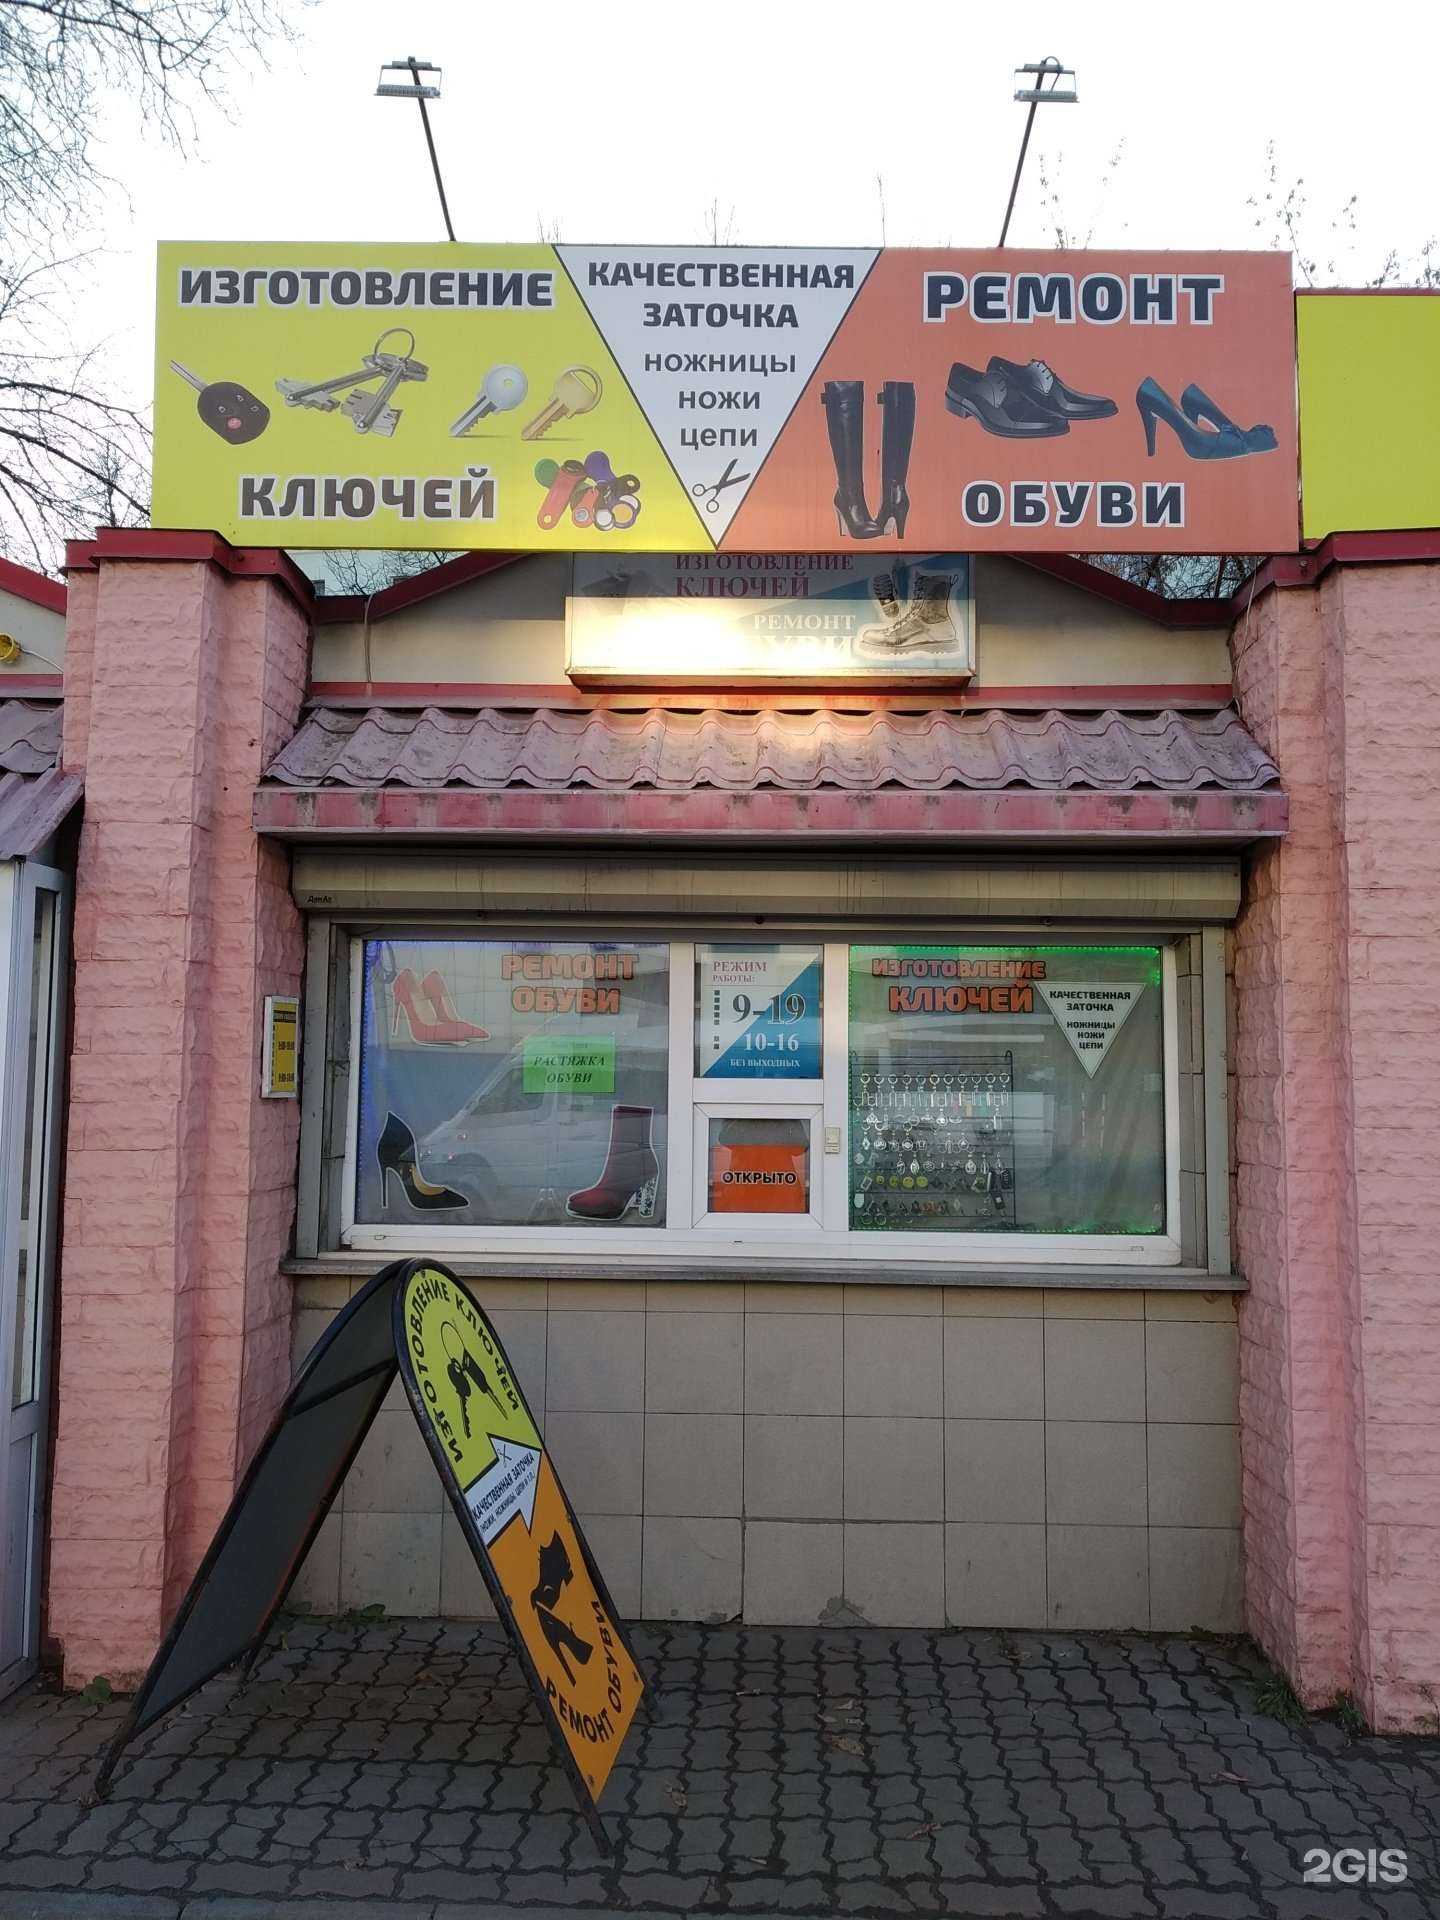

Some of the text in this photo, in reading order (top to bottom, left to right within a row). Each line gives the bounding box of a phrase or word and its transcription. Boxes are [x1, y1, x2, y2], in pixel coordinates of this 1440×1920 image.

[588, 262, 854, 288] КАЧЕСТВЕННАЯ
[179, 268, 554, 308] ИЗГОТОВЛЕНИЕ
[924, 272, 1224, 325] РЕМОНТ
[643, 302, 799, 328] ЗАТОЧКА
[240, 467, 497, 519] КЛЮЧЕЙ
[962, 481, 1185, 527] ОБУВИ
[675, 555, 854, 570] ИЗГОТОВЛЕНИЕ
[675, 572, 809, 597] КЛЮЧЕЙ
[754, 615, 856, 630] РЕМОНТ
[501, 953, 640, 981] РЕМОНТ
[713, 961, 767, 972] РЕЖИМ
[871, 958, 1047, 979] ИЗГОТОВЛЕНИЕ
[512, 986, 621, 1014] ОБУВИ
[888, 978, 1034, 1014] КЛЮЧЕЙ
[1049, 990, 1131, 1000] КАЧЕСТВЕННАЯ
[1066, 1003, 1114, 1011] ЗАТОЧКА
[732, 994, 806, 1025] 9-19
[1067, 1021, 1115, 1030] НОЖНИЦЫ
[743, 1032, 800, 1052] 10-16
[1079, 1042, 1104, 1050] ЦЕПИ
[533, 1055, 606, 1067] РАСТЯЖКА
[748, 1059, 801, 1067] ВЫХОДНЫХ
[546, 1072, 593, 1084] ОБУВИ
[722, 1171, 797, 1185] ОТКРЫТО
[410, 1278, 519, 1463] ИЗГОТОВЛЕНИЕ КЛЮЧЕЙ
[472, 1451, 535, 1521] КАЧЕСТВЕННАЯ ЗАТОЧКА
[545, 1600, 622, 1743] РЕМОНТ ОБУВИ
